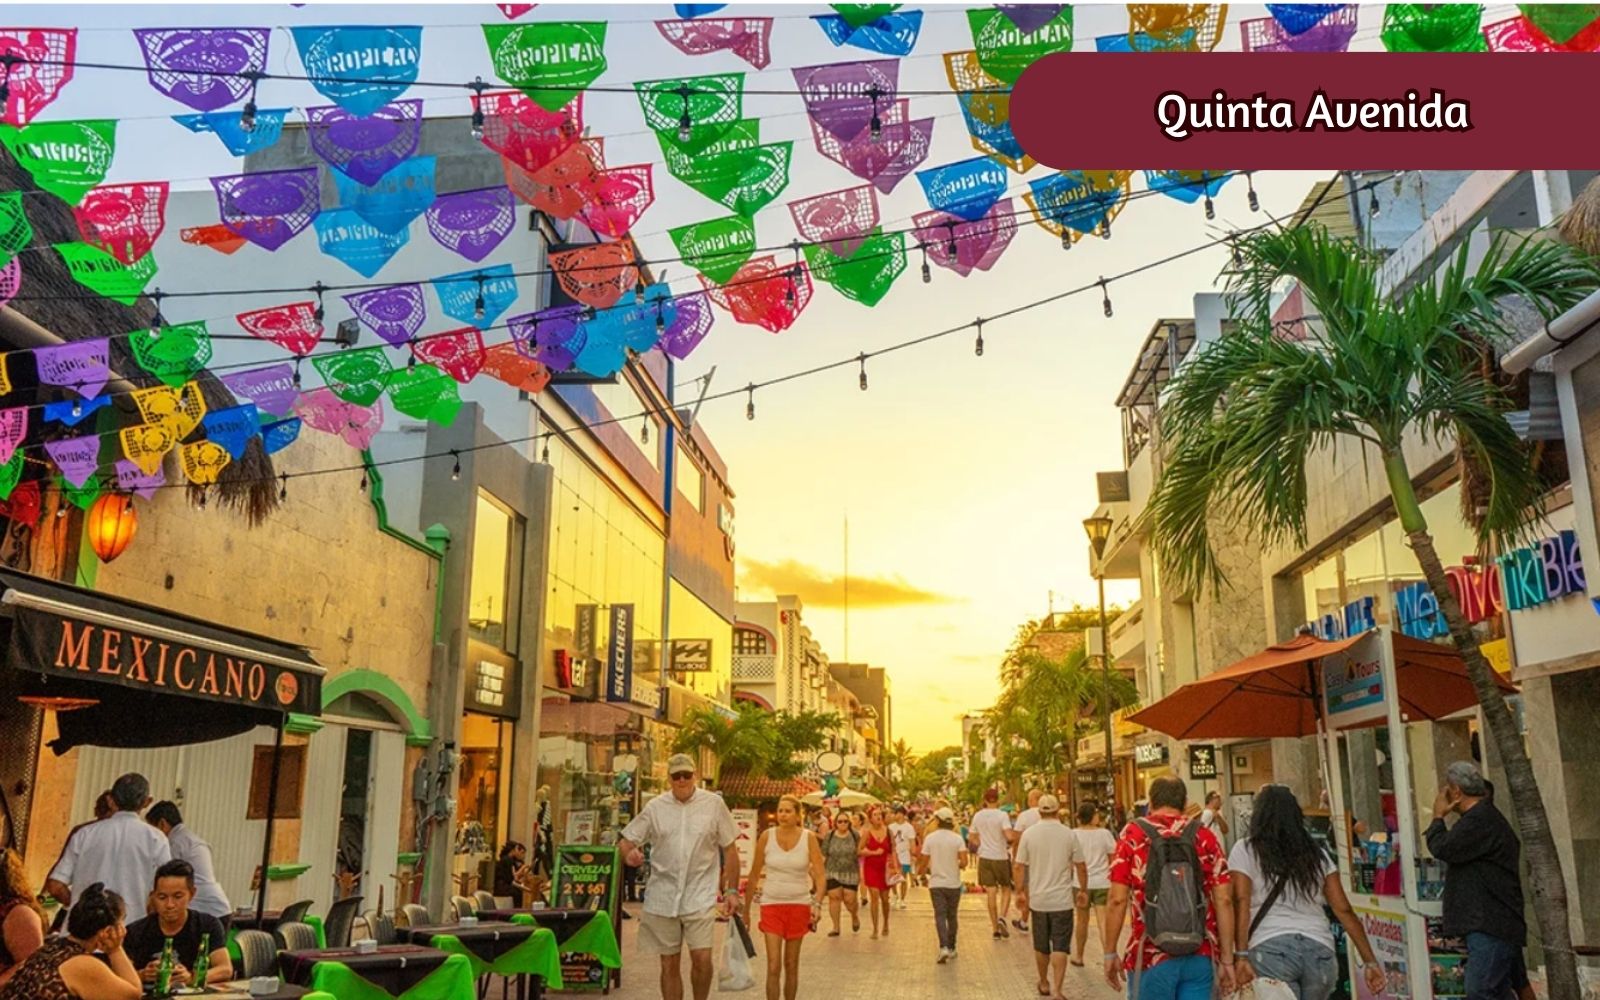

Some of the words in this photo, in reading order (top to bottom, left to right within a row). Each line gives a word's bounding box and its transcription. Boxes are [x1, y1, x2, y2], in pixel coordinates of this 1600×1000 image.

[54, 619, 266, 700] MEXICANO
[613, 607, 627, 698] SKECHERS
[1355, 658, 1380, 679] Tours
[561, 864, 611, 875] CERVEZAS
[563, 882, 572, 895] 2
